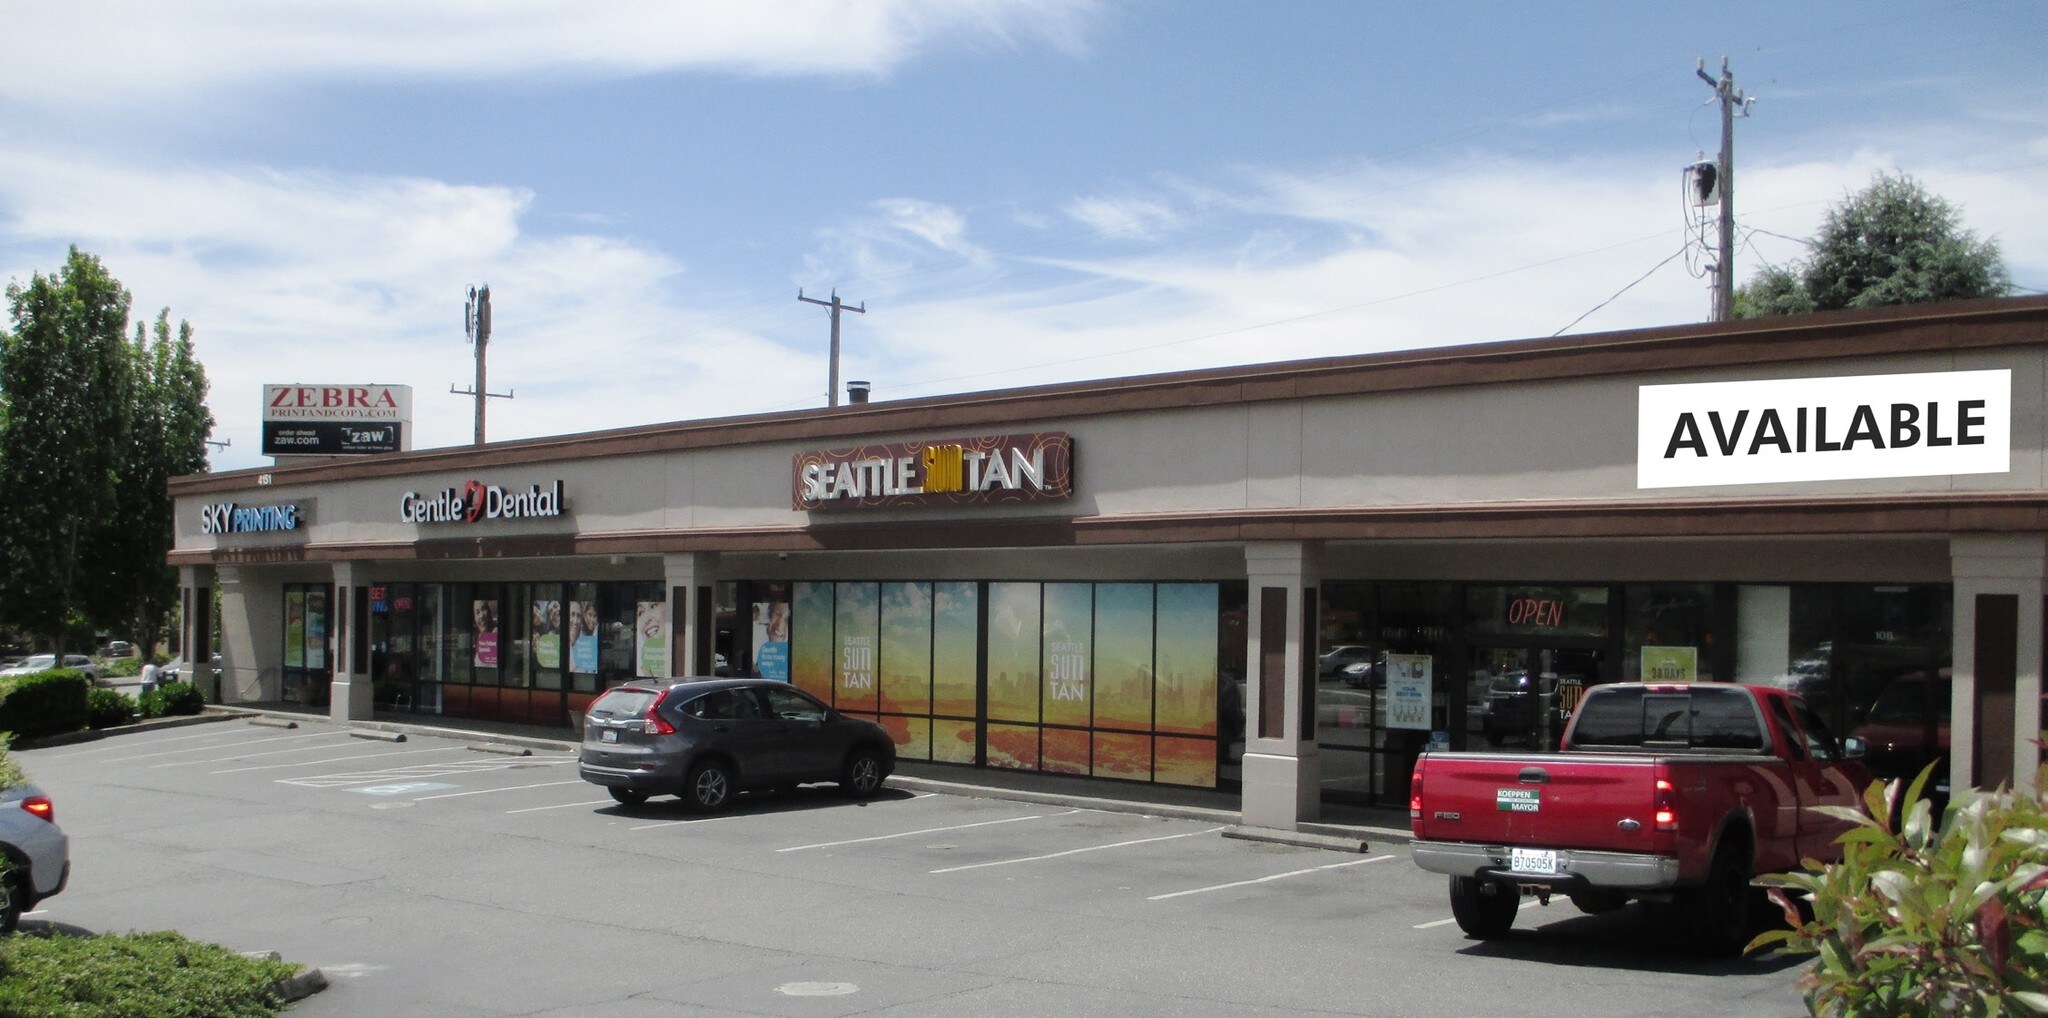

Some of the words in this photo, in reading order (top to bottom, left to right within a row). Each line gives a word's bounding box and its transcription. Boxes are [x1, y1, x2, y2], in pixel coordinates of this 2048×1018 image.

[271, 387, 398, 408] ZEBRA
[271, 408, 396, 418] PRINTANDCOPY.COM
[351, 430, 385, 443] zaw
[1664, 399, 1985, 458] AVAILABLE
[274, 436, 319, 445] zaw.com
[802, 456, 922, 501] SEATTLE
[922, 444, 963, 493] SUN
[964, 447, 1044, 491] TAN
[400, 488, 463, 523] Gentle
[487, 480, 561, 519] Dental
[202, 503, 233, 533] SKY
[233, 504, 295, 532] PRINTING
[1509, 598, 1564, 626] OPEN
[844, 636, 871, 646] SEATTLE
[1875, 631, 1893, 640] 108
[1051, 641, 1084, 653] SEATTLE
[843, 646, 871, 670] SUN
[1050, 654, 1084, 681] SUN
[843, 671, 871, 689] TAN
[1050, 681, 1084, 702] TAN
[1560, 709, 1572, 719] TA
[1497, 790, 1530, 798] KOEPPEN
[1511, 803, 1539, 811] MAYOR
[1514, 856, 1553, 870] B70505K
